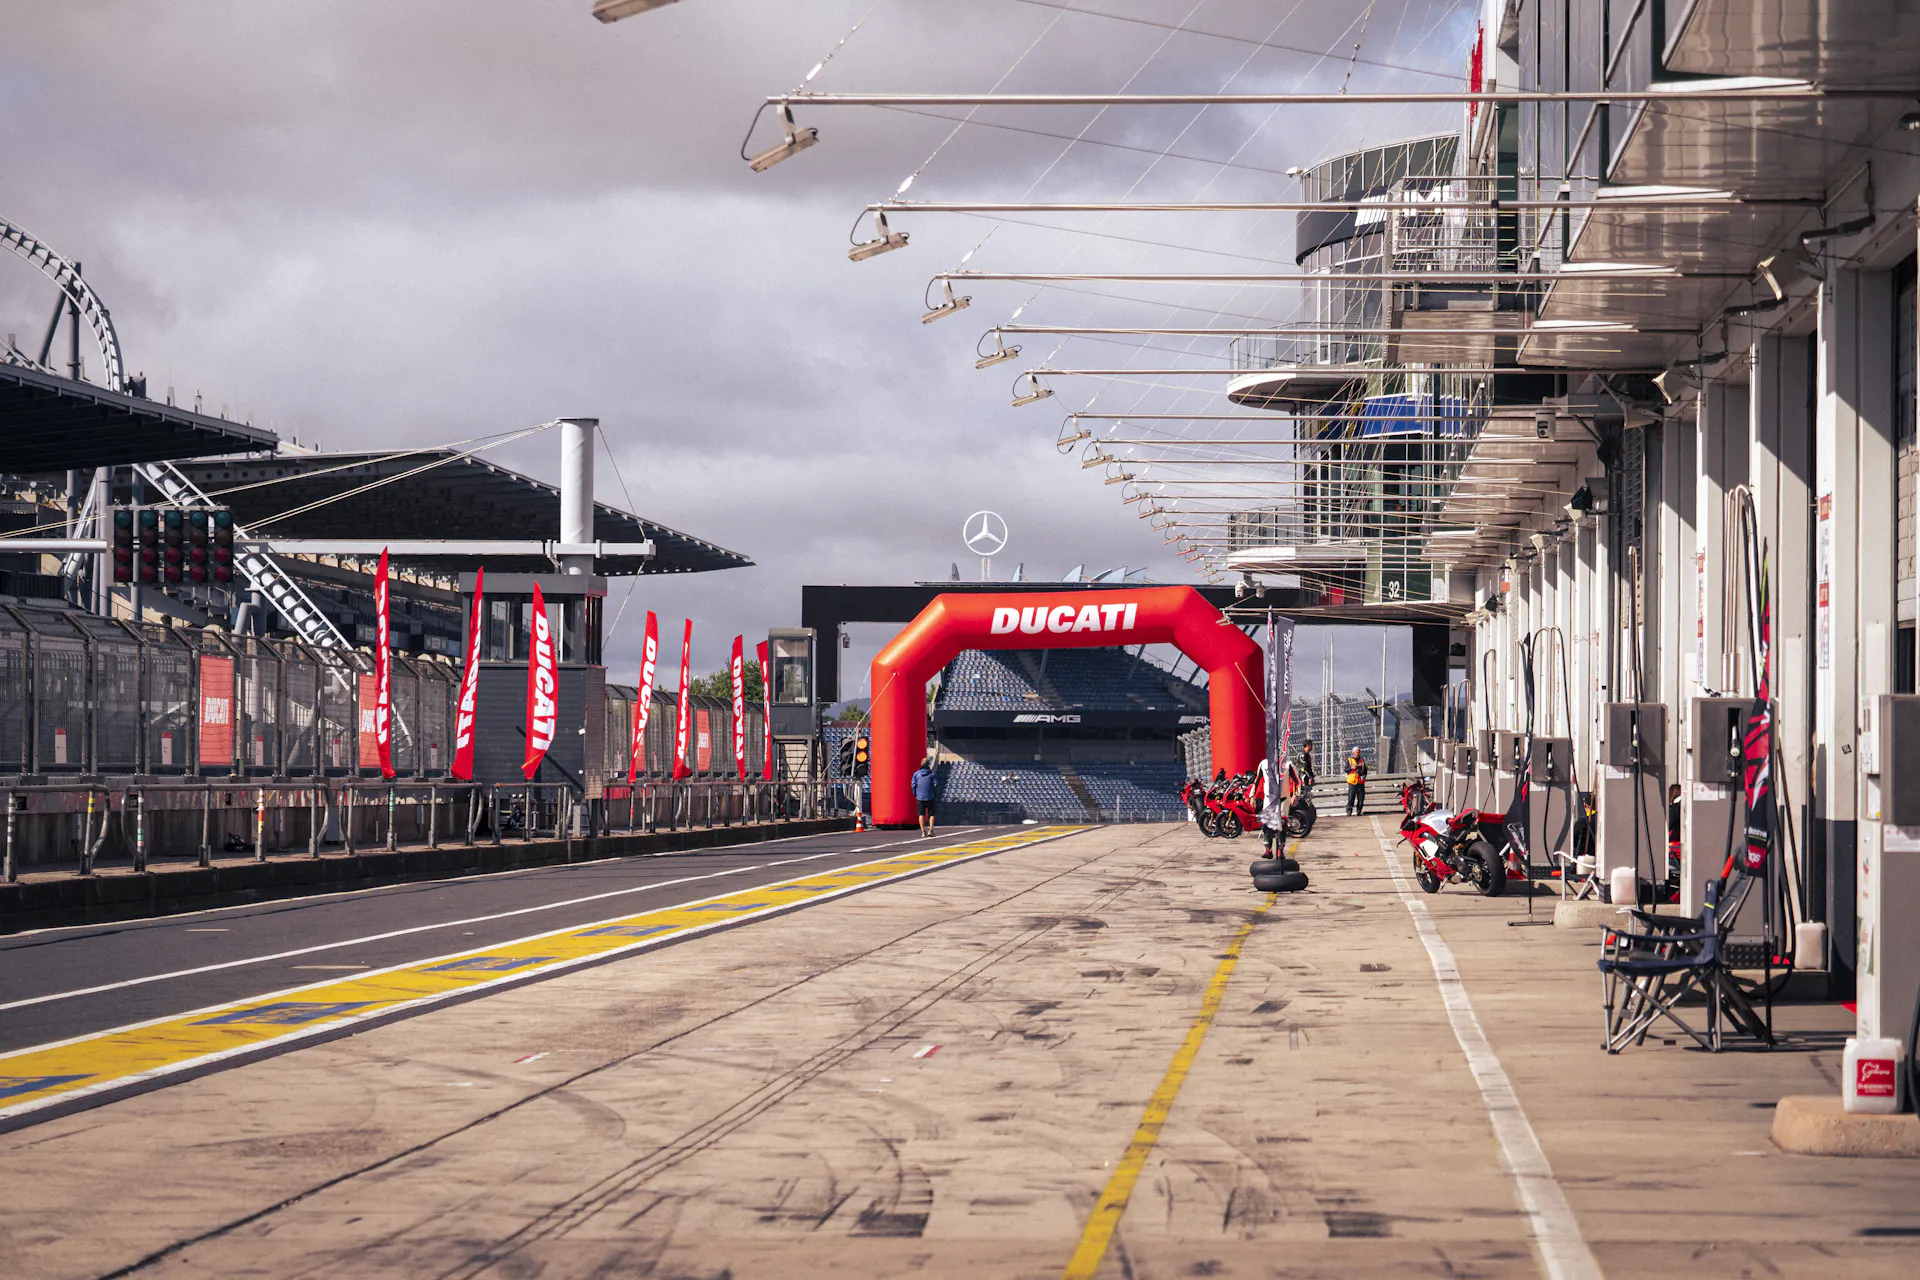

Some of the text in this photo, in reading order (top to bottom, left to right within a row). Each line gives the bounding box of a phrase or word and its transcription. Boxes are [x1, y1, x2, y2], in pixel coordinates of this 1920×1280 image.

[1388, 581, 1400, 598] 32
[990, 602, 1138, 634] DUCATI
[532, 610, 556, 750] DUCATI
[1034, 714, 1081, 723] AMG
